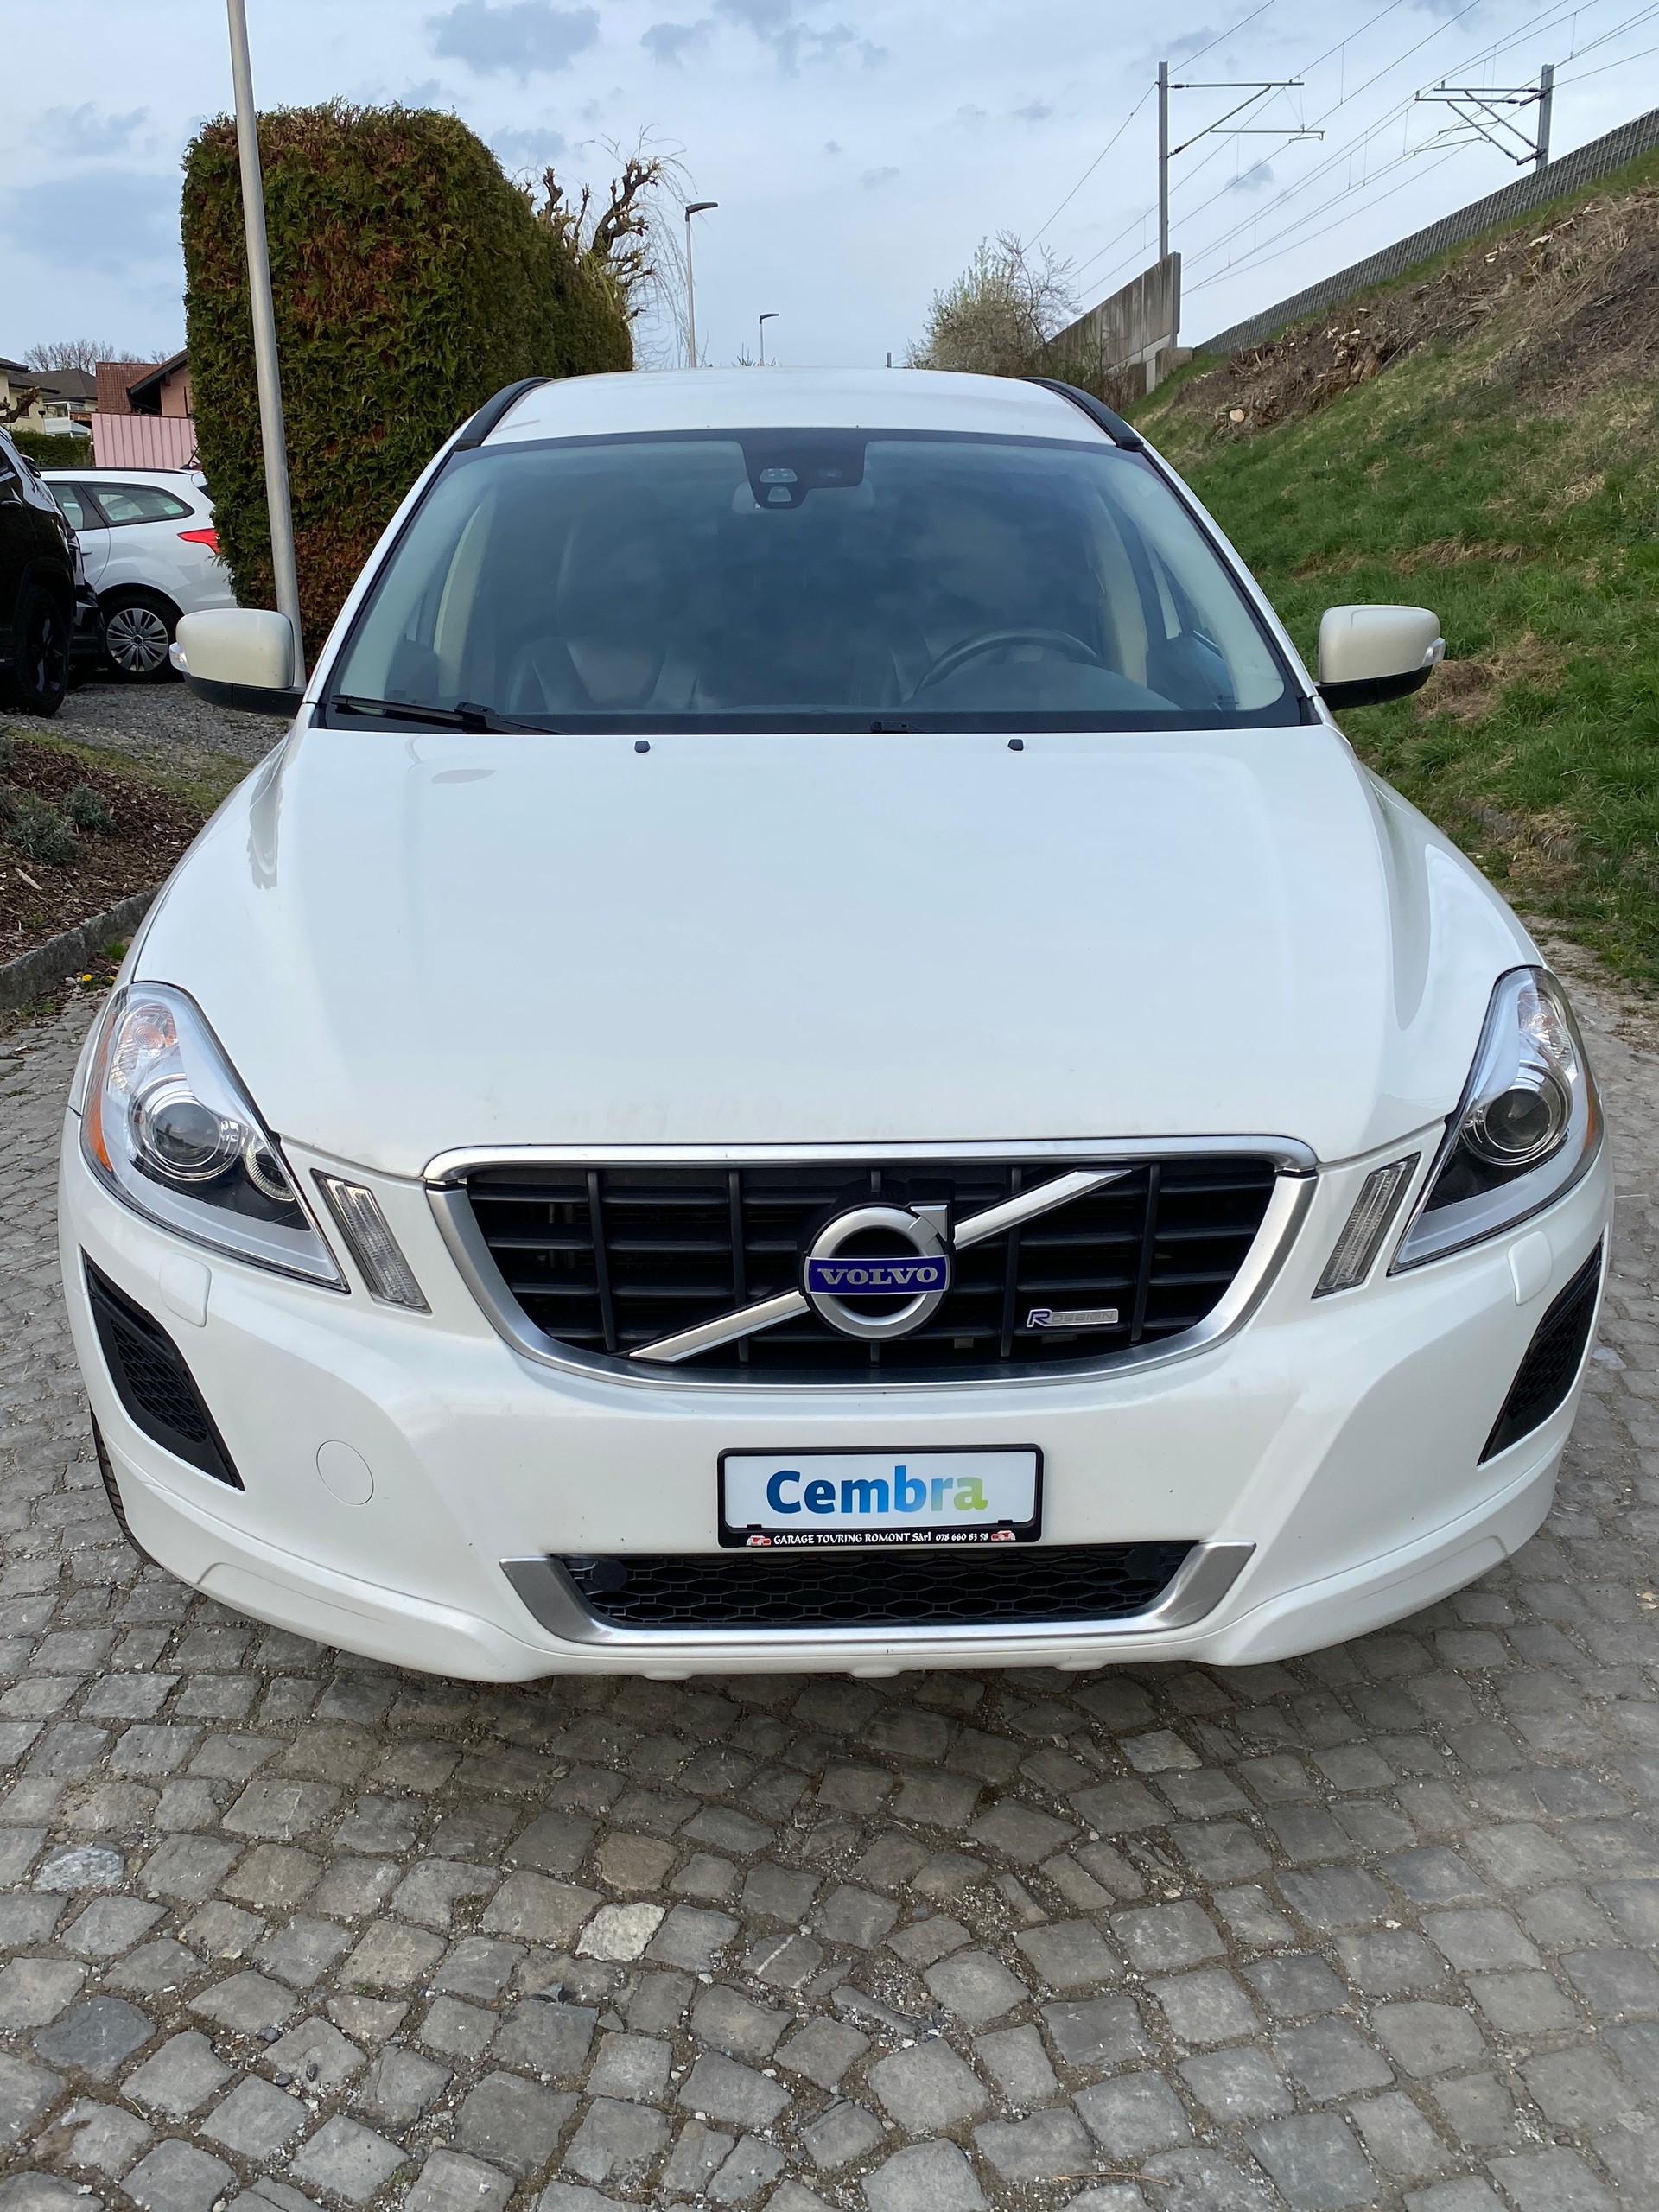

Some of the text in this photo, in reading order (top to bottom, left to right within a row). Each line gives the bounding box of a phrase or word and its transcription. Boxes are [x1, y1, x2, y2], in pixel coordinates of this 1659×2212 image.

[817, 1266, 938, 1286] VOLVO
[766, 1465, 988, 1514] Cembra
[773, 1534, 815, 1545] GARAGE
[816, 1533, 862, 1544] TOURING
[864, 1532, 911, 1542] ROMONT
[935, 1533, 950, 1541] 078
[950, 1533, 967, 1541] 660
[968, 1532, 978, 1541] 83
[979, 1532, 989, 1541] 58
